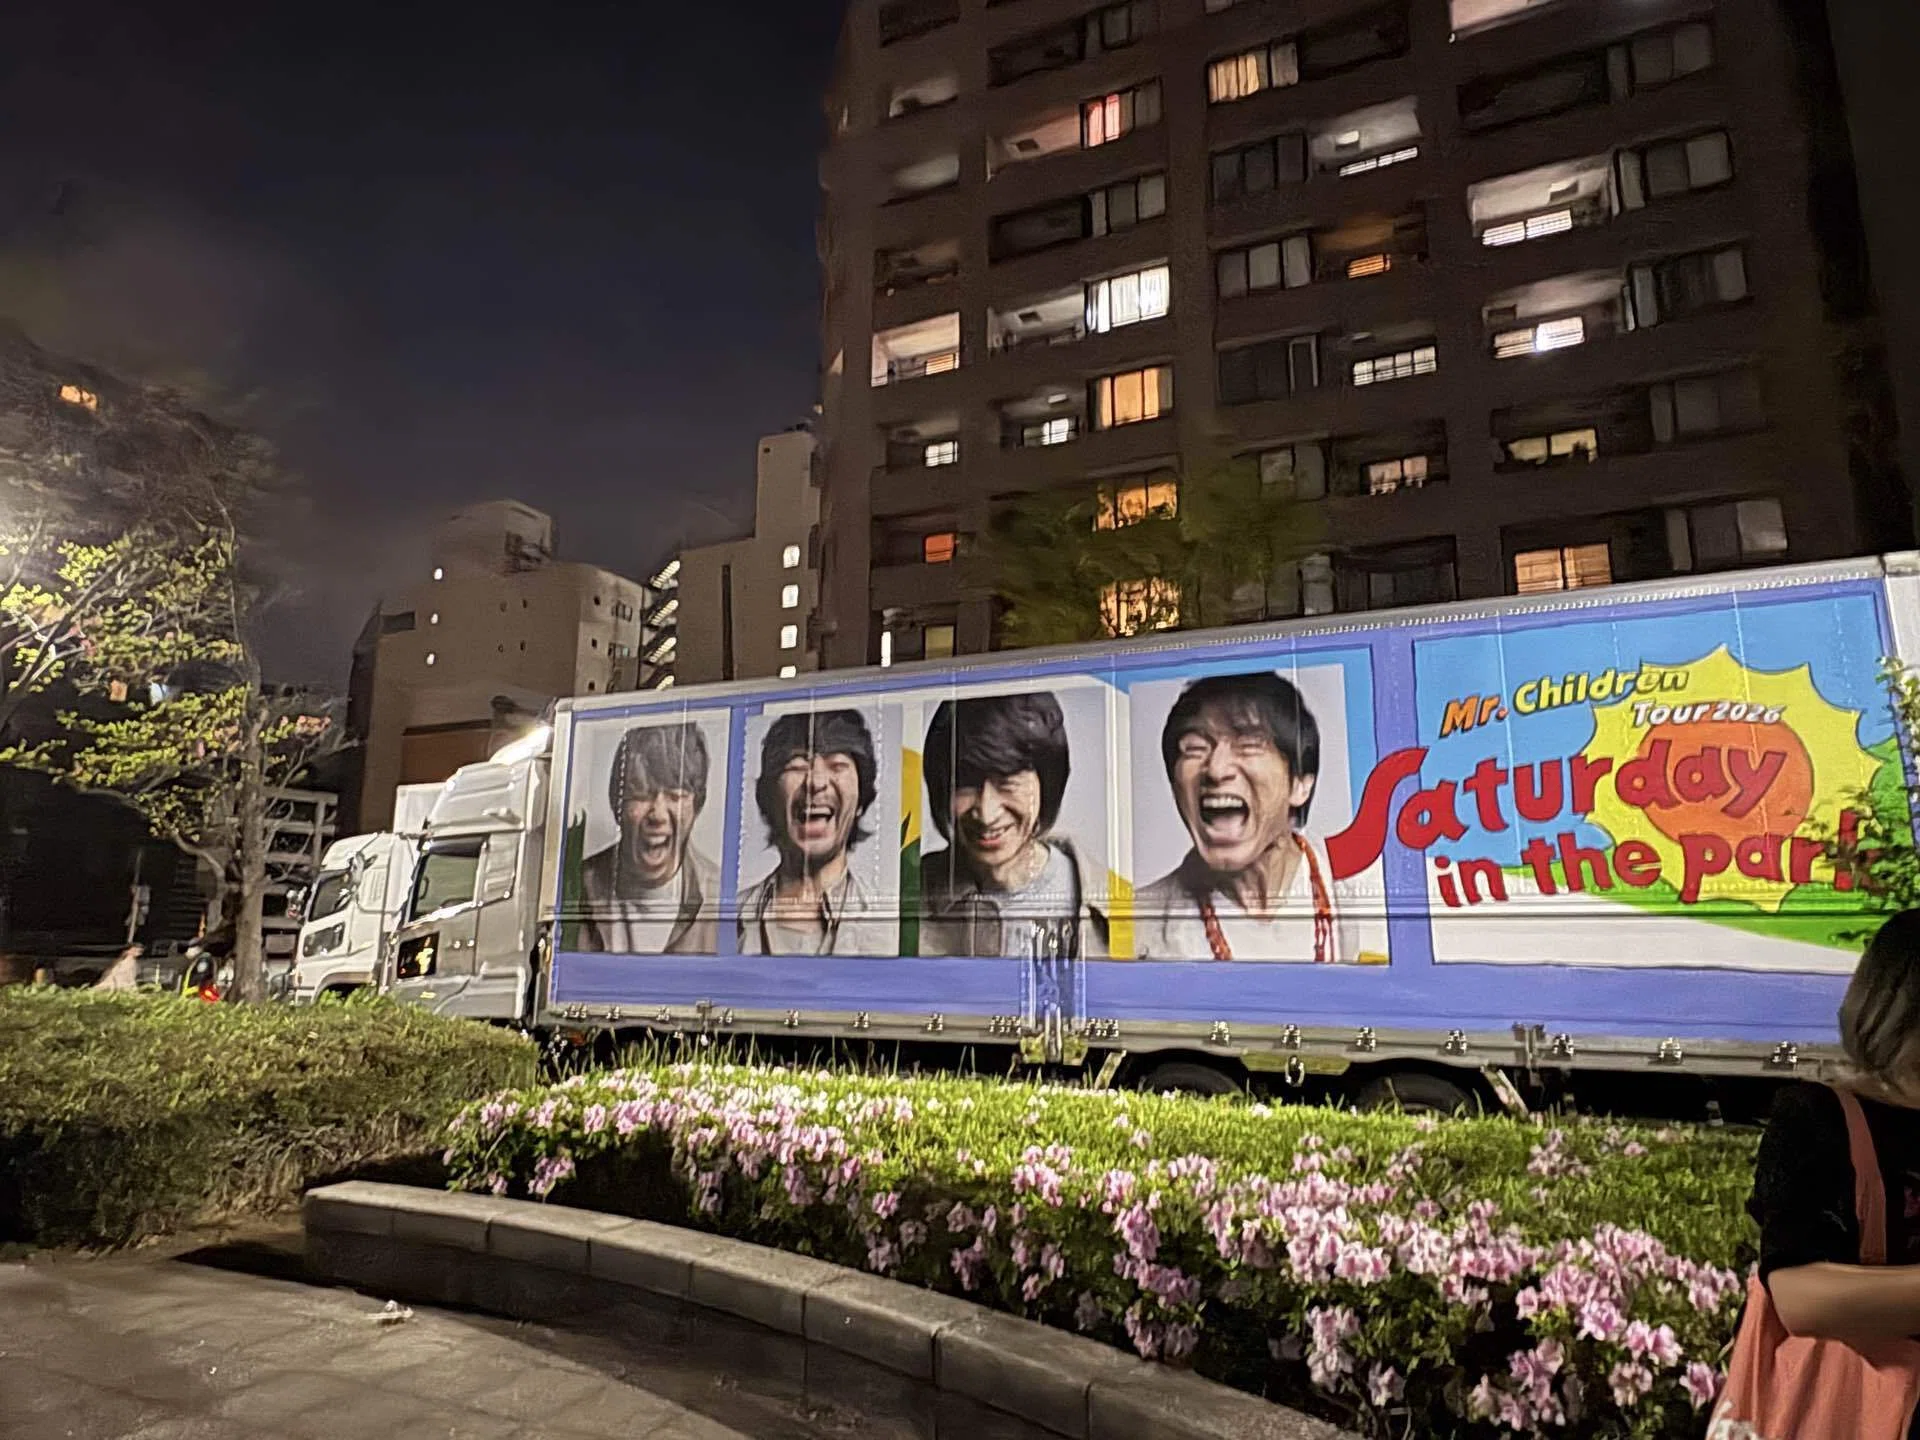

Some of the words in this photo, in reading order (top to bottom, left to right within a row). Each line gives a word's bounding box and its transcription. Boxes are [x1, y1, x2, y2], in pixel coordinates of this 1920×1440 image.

[1439, 694, 1509, 739] Mr.
[1513, 668, 1690, 716] Children
[1632, 699, 1710, 728] Tour
[1711, 700, 1786, 725] 2026
[1324, 738, 1787, 881] Saturday
[1436, 855, 1509, 908] in
[1523, 831, 1663, 895] the
